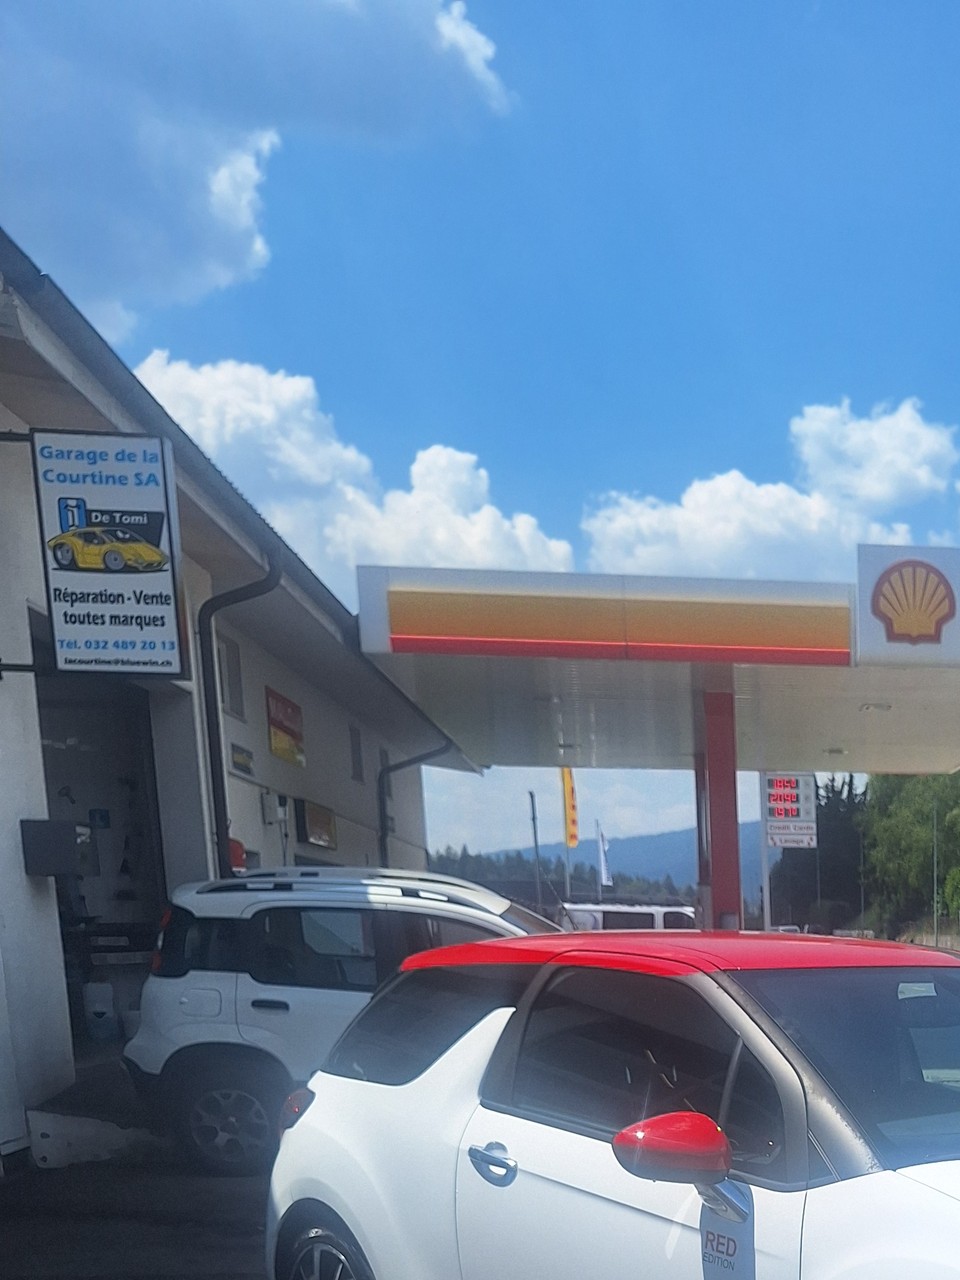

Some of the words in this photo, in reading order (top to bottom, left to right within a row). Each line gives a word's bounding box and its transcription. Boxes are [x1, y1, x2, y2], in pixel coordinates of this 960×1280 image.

[38, 444, 109, 466] Garage
[115, 448, 137, 463] de
[142, 449, 159, 463] la
[42, 469, 129, 487] Courtine
[133, 472, 160, 487] SA
[91, 511, 110, 524] De
[113, 512, 148, 525] Tomi
[53, 586, 125, 608] Réparation
[133, 589, 173, 607] Vente
[62, 610, 106, 626] toutes
[109, 613, 166, 632] marques
[84, 639, 109, 651] 032
[112, 640, 137, 651] 489
[141, 641, 156, 651] 20
[161, 641, 176, 652] 13
[704, 1229, 737, 1257] RED
[702, 1251, 735, 1271] EDITION
